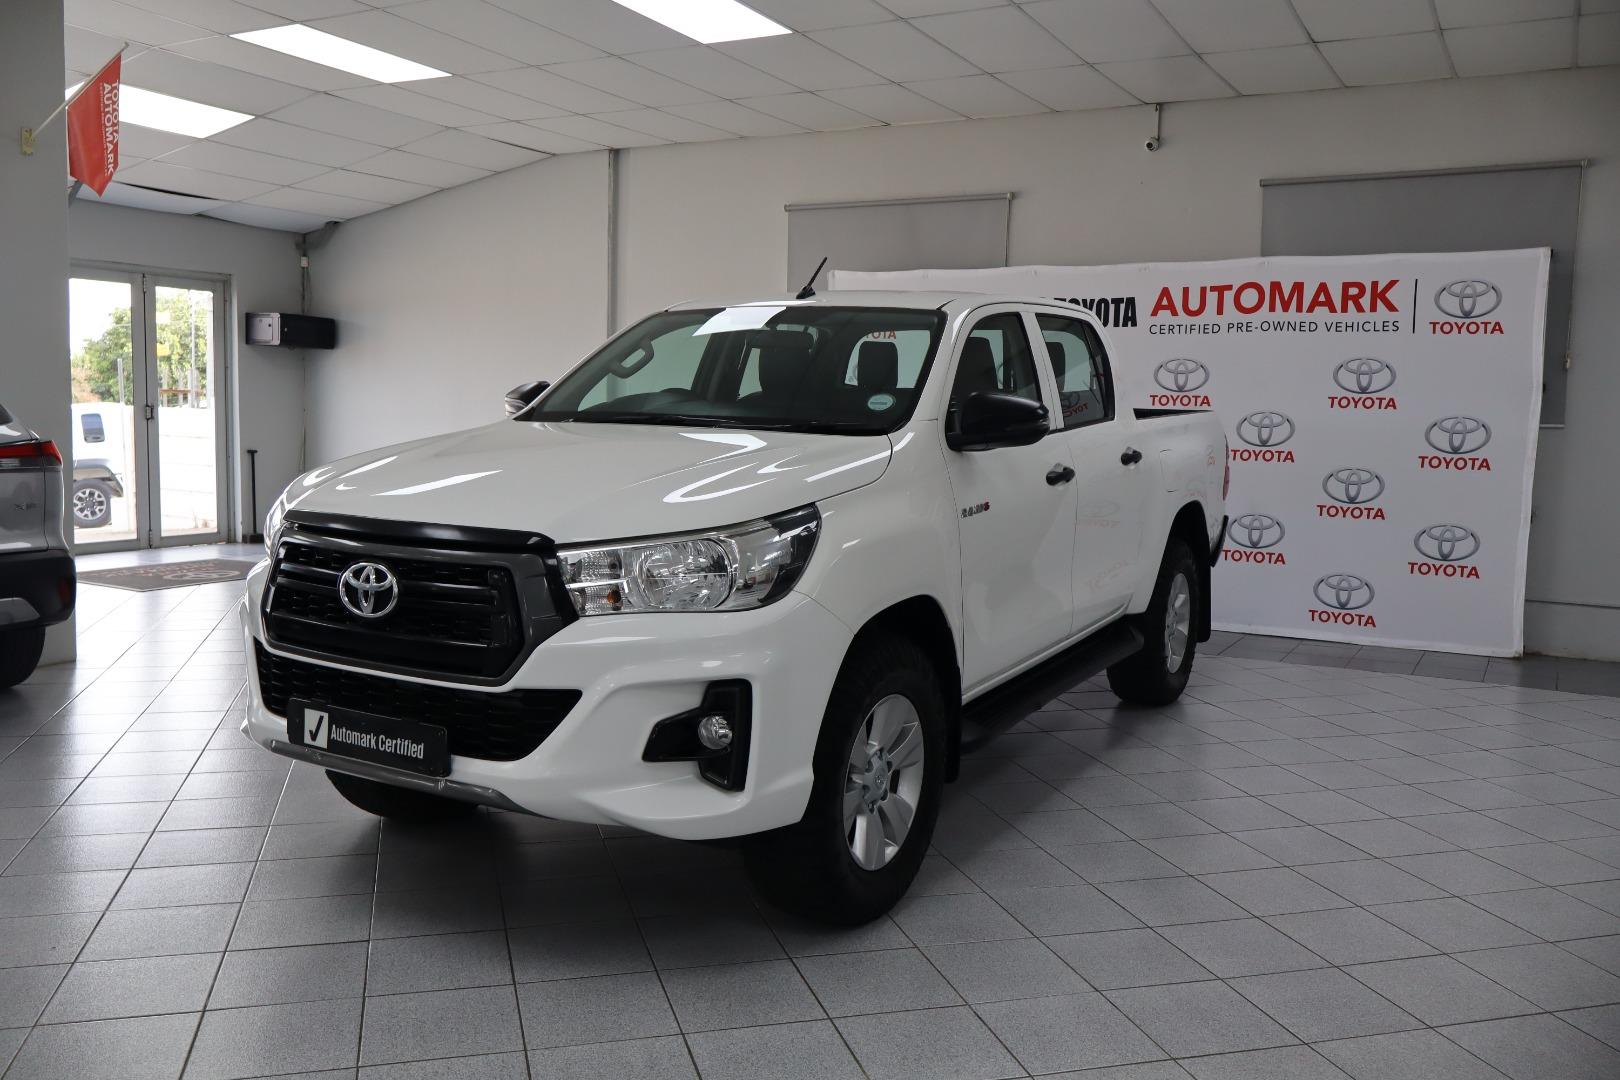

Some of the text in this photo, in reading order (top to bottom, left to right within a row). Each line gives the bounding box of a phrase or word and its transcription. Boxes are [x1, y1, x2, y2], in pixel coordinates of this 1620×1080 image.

[111, 80, 119, 143] TOYOTA
[103, 83, 114, 176] AUTOMARK
[1150, 279, 1400, 317] AUTOMARK
[1054, 297, 1137, 327] OTA
[1149, 320, 1400, 335] CERTIFIED PRE-OWNED VEHICLES
[1430, 320, 1504, 336] TOYOTA
[1150, 394, 1212, 408] TOYOTA
[1328, 396, 1397, 411] TOYOTA
[1231, 448, 1295, 464] TOYOTA
[1419, 454, 1492, 472] TOYOTA
[1317, 504, 1386, 521] TOYOTA
[1222, 549, 1286, 565] TOYOTA
[1409, 562, 1480, 580] TOYOTA
[1310, 609, 1376, 628] TOYOTA
[331, 724, 424, 760] Automark Certified
